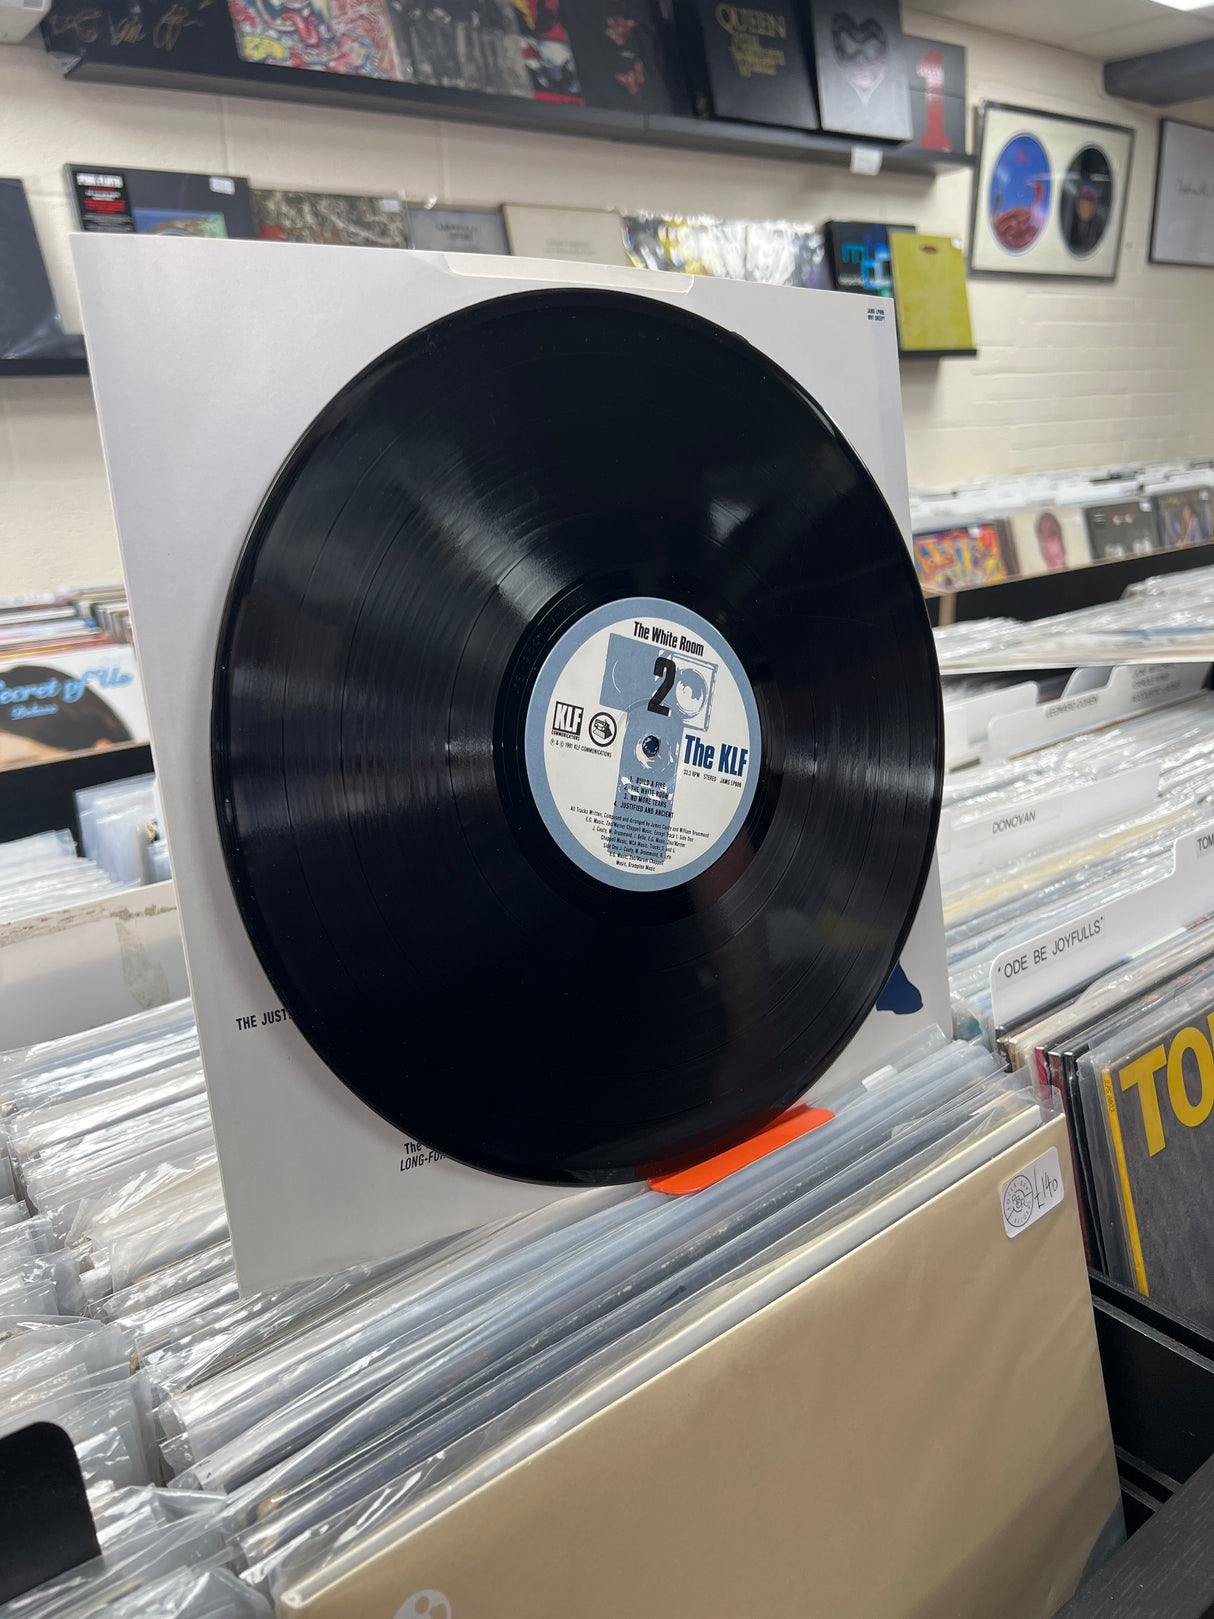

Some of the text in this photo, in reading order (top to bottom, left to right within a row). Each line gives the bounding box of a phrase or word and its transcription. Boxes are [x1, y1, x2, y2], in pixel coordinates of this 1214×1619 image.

[715, 4, 787, 38] QUEEN
[634, 621, 704, 656] The White Room
[647, 656, 676, 717] 2
[554, 702, 583, 733] KLF
[551, 730, 580, 741] COMMUNICATIONS
[581, 745, 612, 758] COMMUNICATIONS
[684, 734, 748, 777] The KLF
[636, 777, 650, 786] BUILD
[655, 781, 666, 789] FIRE
[704, 774, 717, 782] STEREO
[638, 796, 651, 805] MORE
[653, 800, 667, 808] TEARS
[641, 788, 655, 796] WHITE
[656, 790, 669, 799] ROOM
[620, 802, 643, 812] JUSTIFIED
[644, 806, 654, 814] AND
[655, 809, 674, 818] ANCIENT
[992, 810, 1036, 834] DONOVAN
[1033, 945, 1047, 964] BE
[236, 1008, 291, 1030] THE JUST
[1119, 1011, 1214, 1157] TO
[404, 1141, 422, 1154] The
[1034, 1168, 1058, 1209] £140
